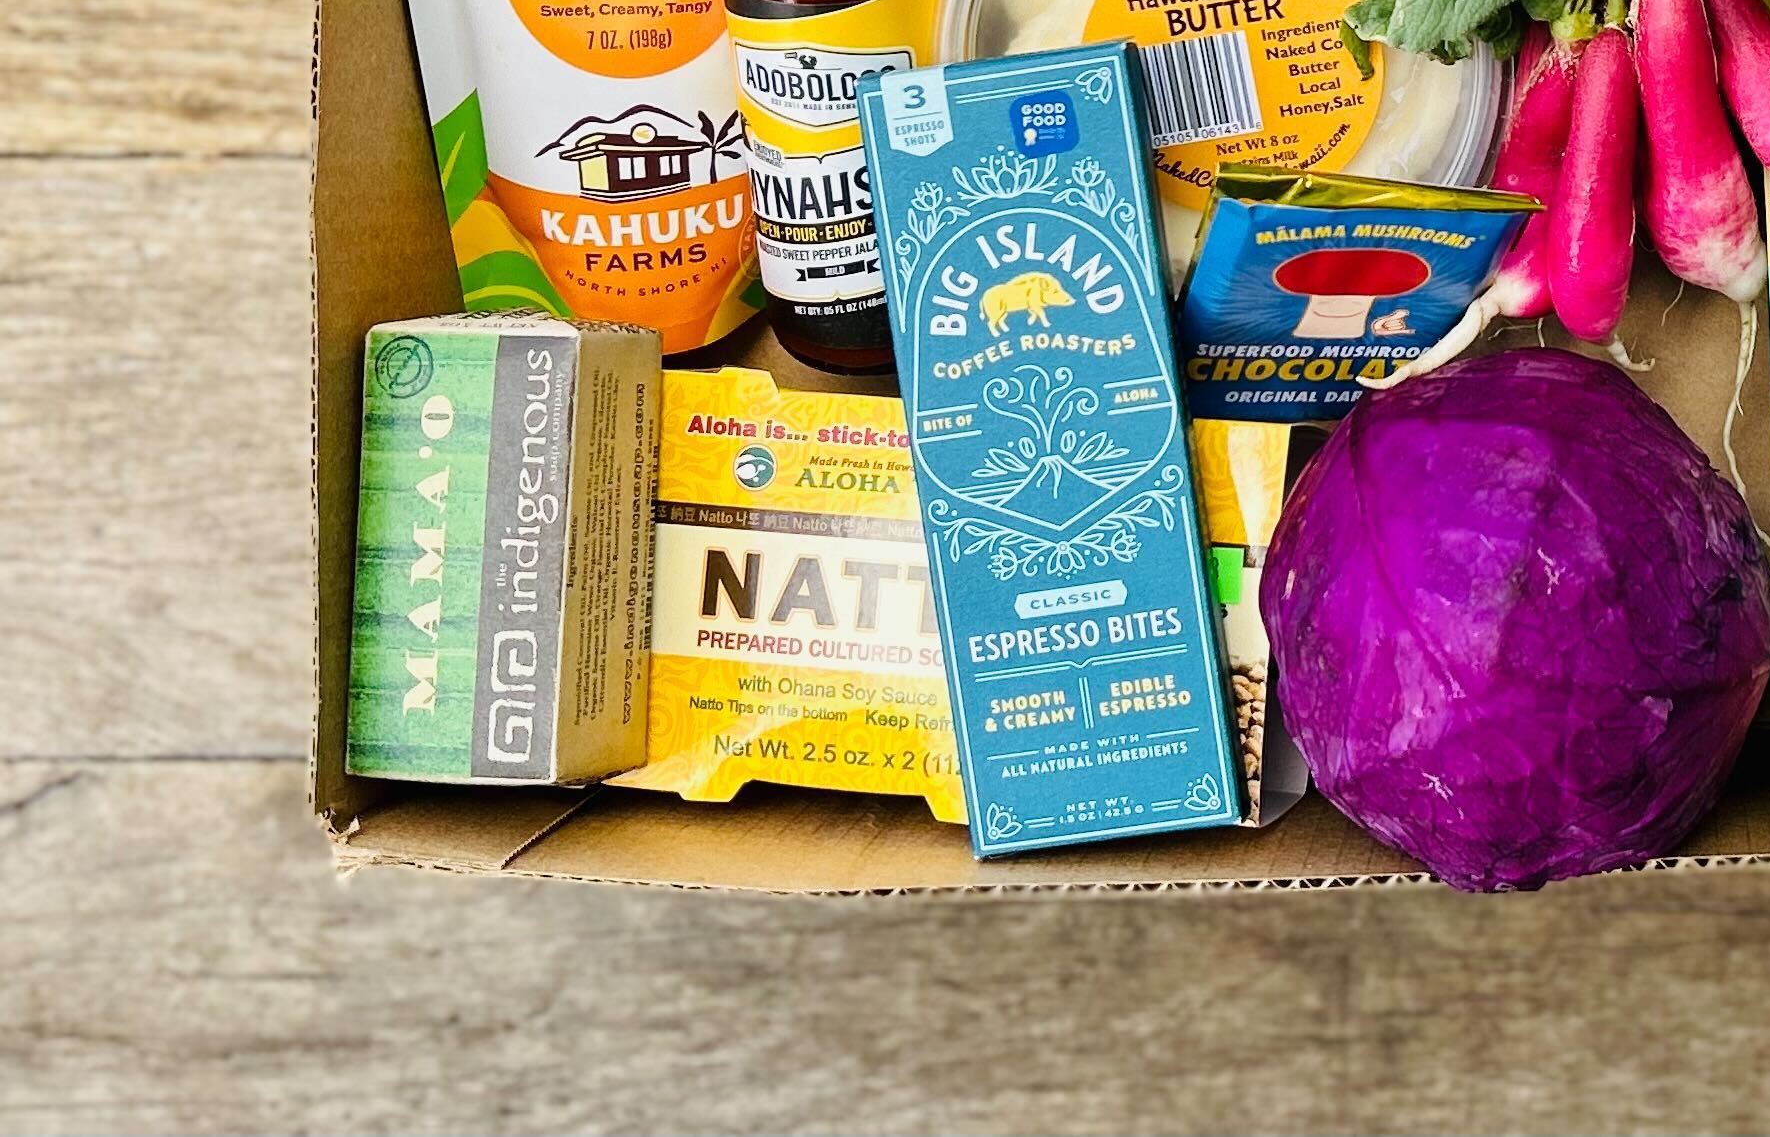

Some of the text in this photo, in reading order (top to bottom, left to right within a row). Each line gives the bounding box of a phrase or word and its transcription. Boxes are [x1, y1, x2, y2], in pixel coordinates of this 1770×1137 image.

[540, 1, 713, 18] Sweet, Creamy, Tangy
[629, 28, 672, 50] (198g)
[1266, 43, 1316, 60] Naked
[1289, 60, 1341, 77] Butter
[904, 84, 927, 109] 3
[1299, 78, 1341, 95] Local
[1021, 103, 1065, 115] GOOD
[1023, 114, 1066, 127] FOOD
[895, 120, 945, 136] ESPRESSO
[904, 134, 937, 146] SHOTS
[1216, 142, 1242, 155] Net
[540, 193, 744, 248] KAHUKU
[785, 219, 867, 242] POUR ENJOY
[1352, 224, 1476, 248] MUSHROOMS
[584, 243, 708, 272] FARMS
[813, 246, 851, 260] PEPPER
[565, 269, 701, 297] NORTH SHORE
[930, 223, 1125, 336] BIG ISLAND
[933, 333, 1136, 380] COFFEE ROASTERS
[1196, 343, 1320, 359] SUPERFOOD
[1114, 388, 1158, 403] ALOHA
[1225, 390, 1317, 403] ORIGINAL
[550, 373, 564, 442] company
[687, 415, 757, 438] Aloha
[923, 417, 952, 431] BITE
[499, 348, 559, 616] indigenous
[795, 468, 900, 494] ALOHA
[1030, 589, 1111, 609] CLASSIC
[697, 629, 912, 664] PREPARED CULTURED
[968, 607, 1183, 663] ESPRESSO BITES
[738, 675, 938, 707] with Ohana Soy Sauce
[1110, 674, 1176, 697] EDIBLE
[689, 696, 848, 722] Natto Tips bottom
[991, 691, 1066, 712] SMOOTH
[1099, 691, 1191, 717] ESPRESSO
[865, 709, 911, 730] Keep
[1003, 707, 1076, 731] CREAMY
[714, 734, 875, 765] Net Wt. 2.5 oz.
[1044, 734, 1140, 755] MADE WITH
[1002, 741, 1188, 778] ALL NATURAL INGREDIENTS
